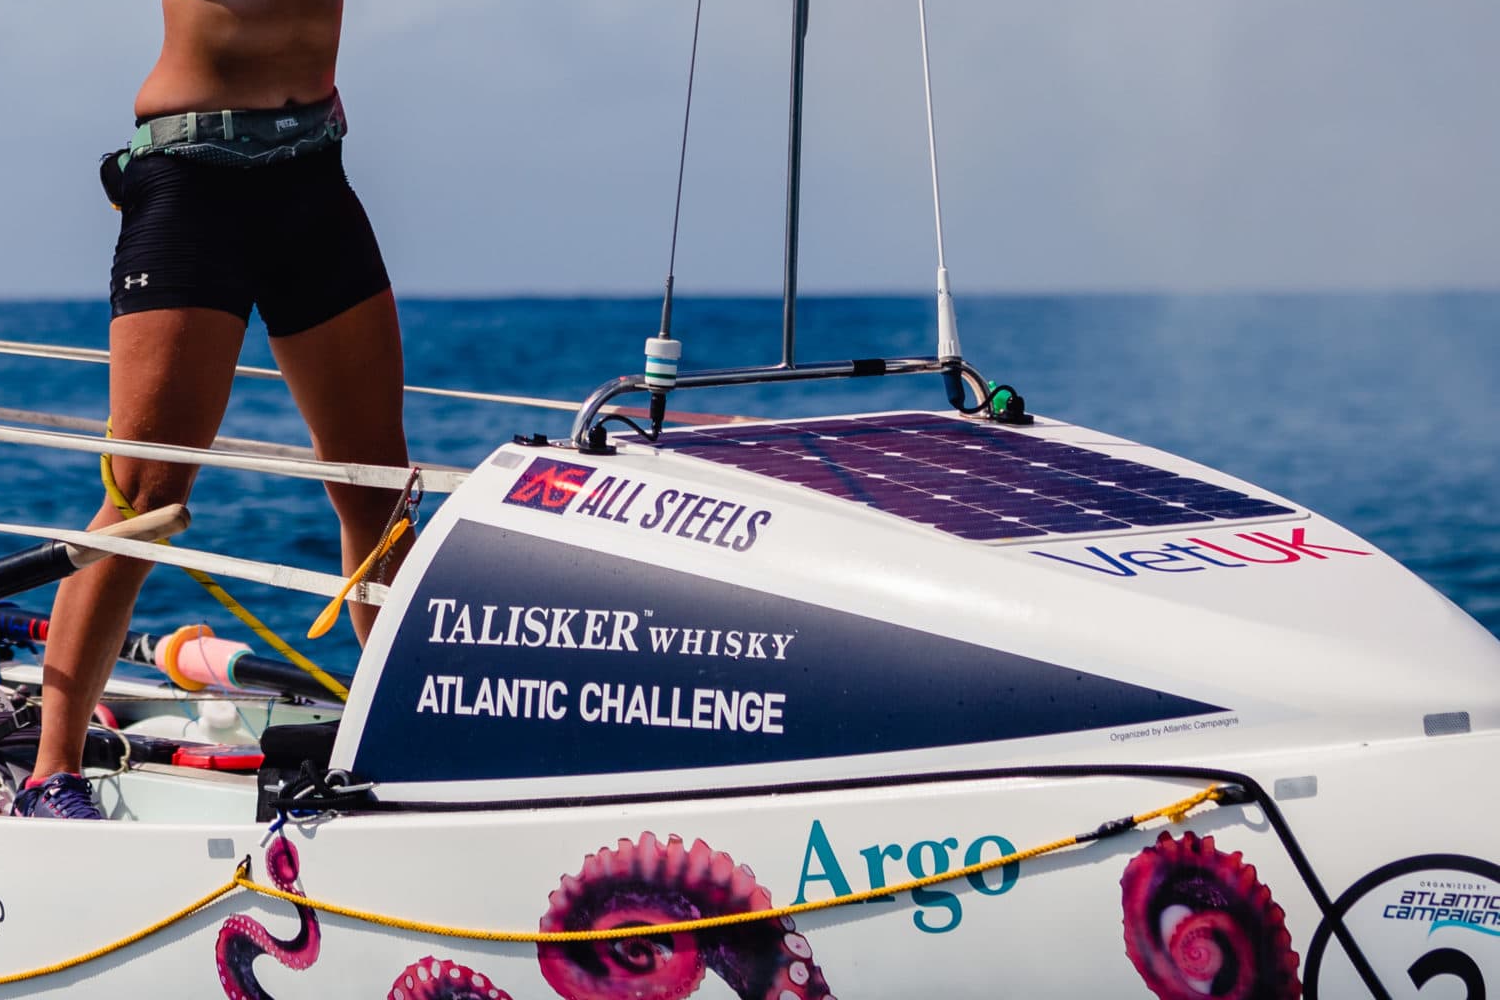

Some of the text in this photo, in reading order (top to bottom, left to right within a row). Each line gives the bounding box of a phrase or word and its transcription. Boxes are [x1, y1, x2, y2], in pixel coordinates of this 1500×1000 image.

[575, 475, 647, 524] ALL
[639, 488, 772, 552] STEELS
[1027, 527, 1374, 577] VetUK
[427, 597, 639, 652] TALISKER
[648, 626, 795, 660] WHISKY
[416, 674, 787, 734] ATLANTIC CHALLENGE
[1110, 716, 1239, 742] Organized by Atlantic Campaigns
[790, 819, 1020, 934] Argo
[1419, 881, 1473, 890] ORGANIZED
